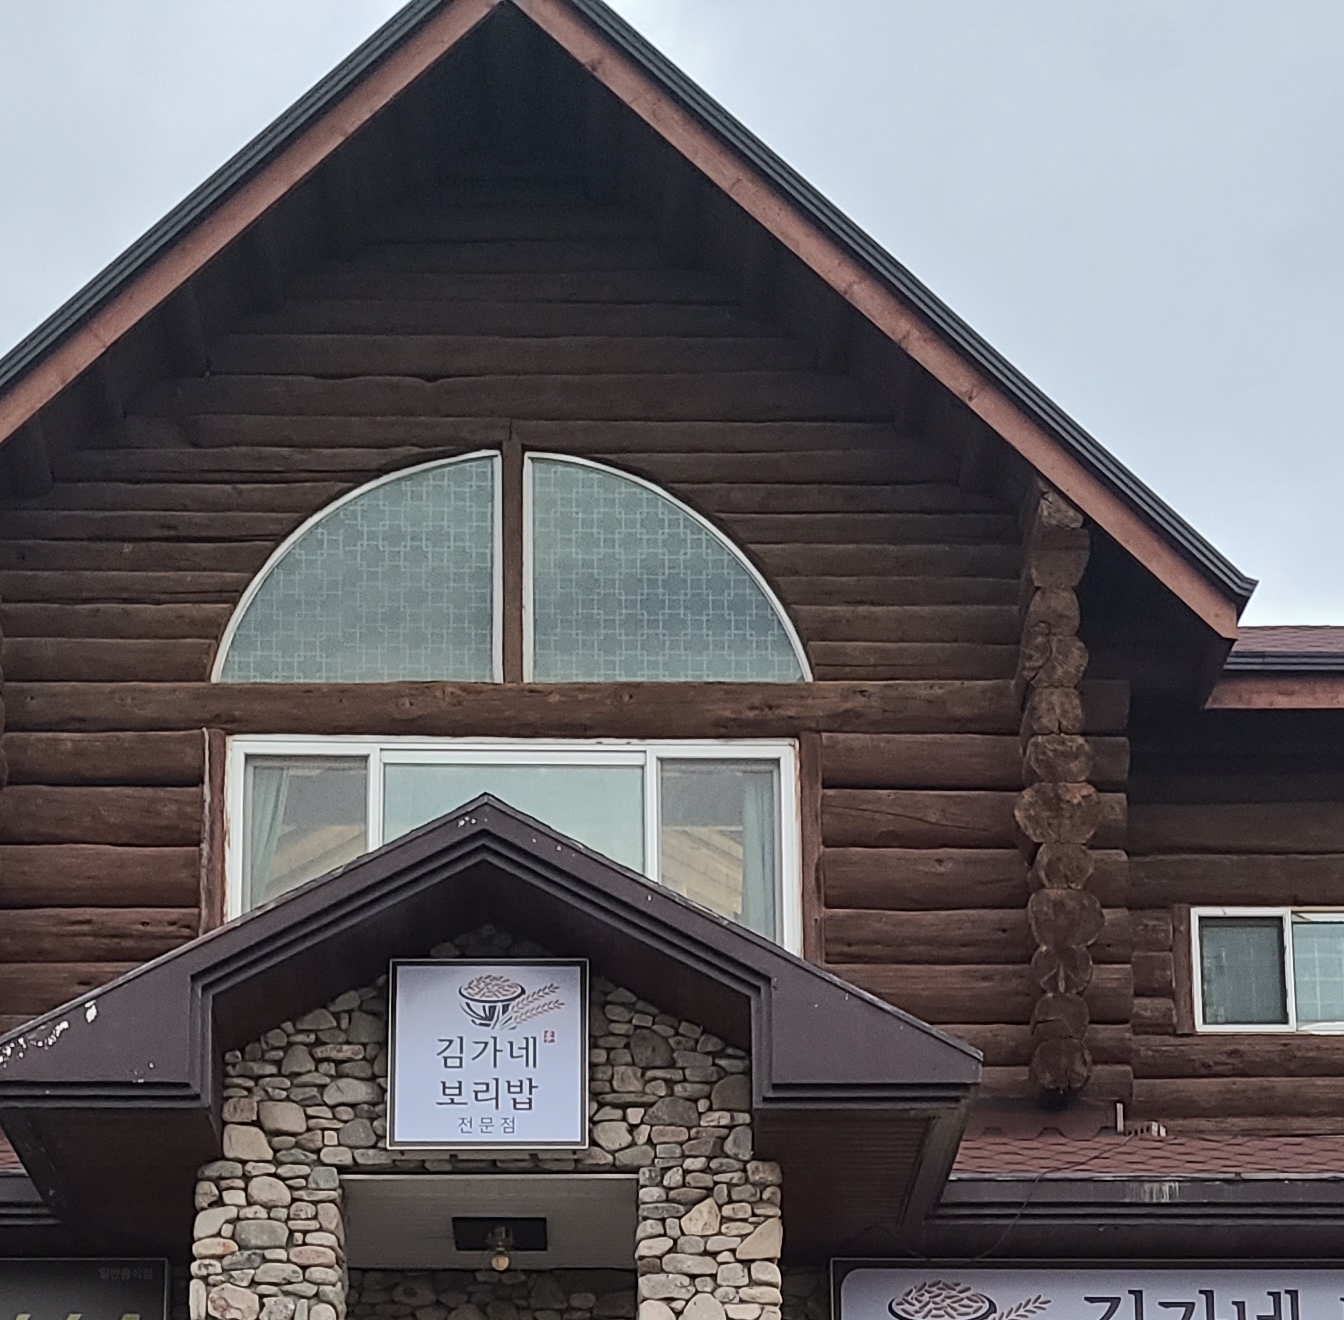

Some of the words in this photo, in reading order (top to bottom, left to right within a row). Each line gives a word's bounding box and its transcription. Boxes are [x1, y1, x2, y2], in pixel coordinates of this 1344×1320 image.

[436, 1036, 538, 1069] 김가네
[435, 1077, 539, 1111] 보리밥
[458, 1116, 516, 1134] 전문점
